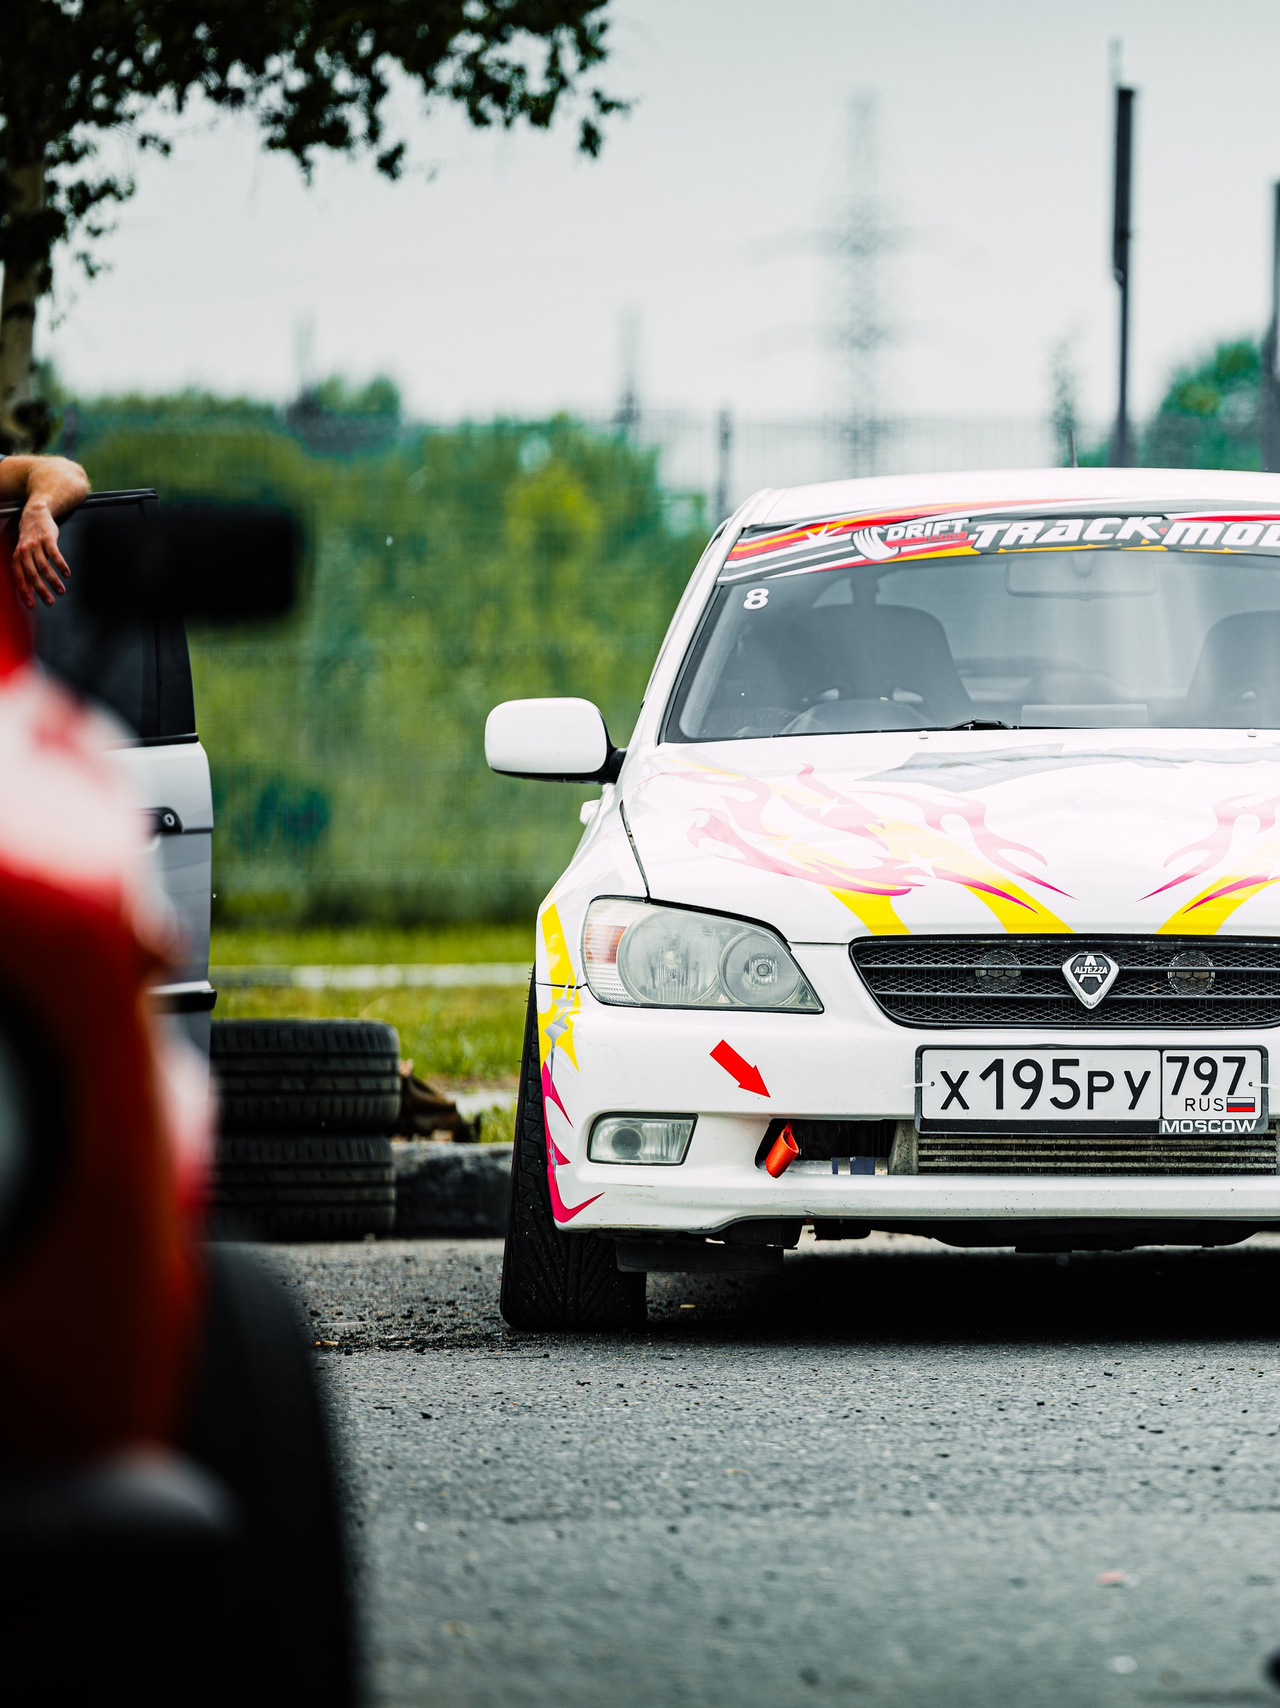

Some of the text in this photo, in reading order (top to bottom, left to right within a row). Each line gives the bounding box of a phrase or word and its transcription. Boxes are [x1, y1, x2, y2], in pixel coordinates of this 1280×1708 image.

[886, 518, 969, 541] DRIFT
[974, 516, 1163, 549] TRACK
[743, 588, 769, 610] 8
[1074, 966, 1108, 974] ALTEZZA
[1166, 1056, 1246, 1096] 797
[1184, 1098, 1224, 1112] RUS
[1161, 1119, 1257, 1133] MOSCOW
